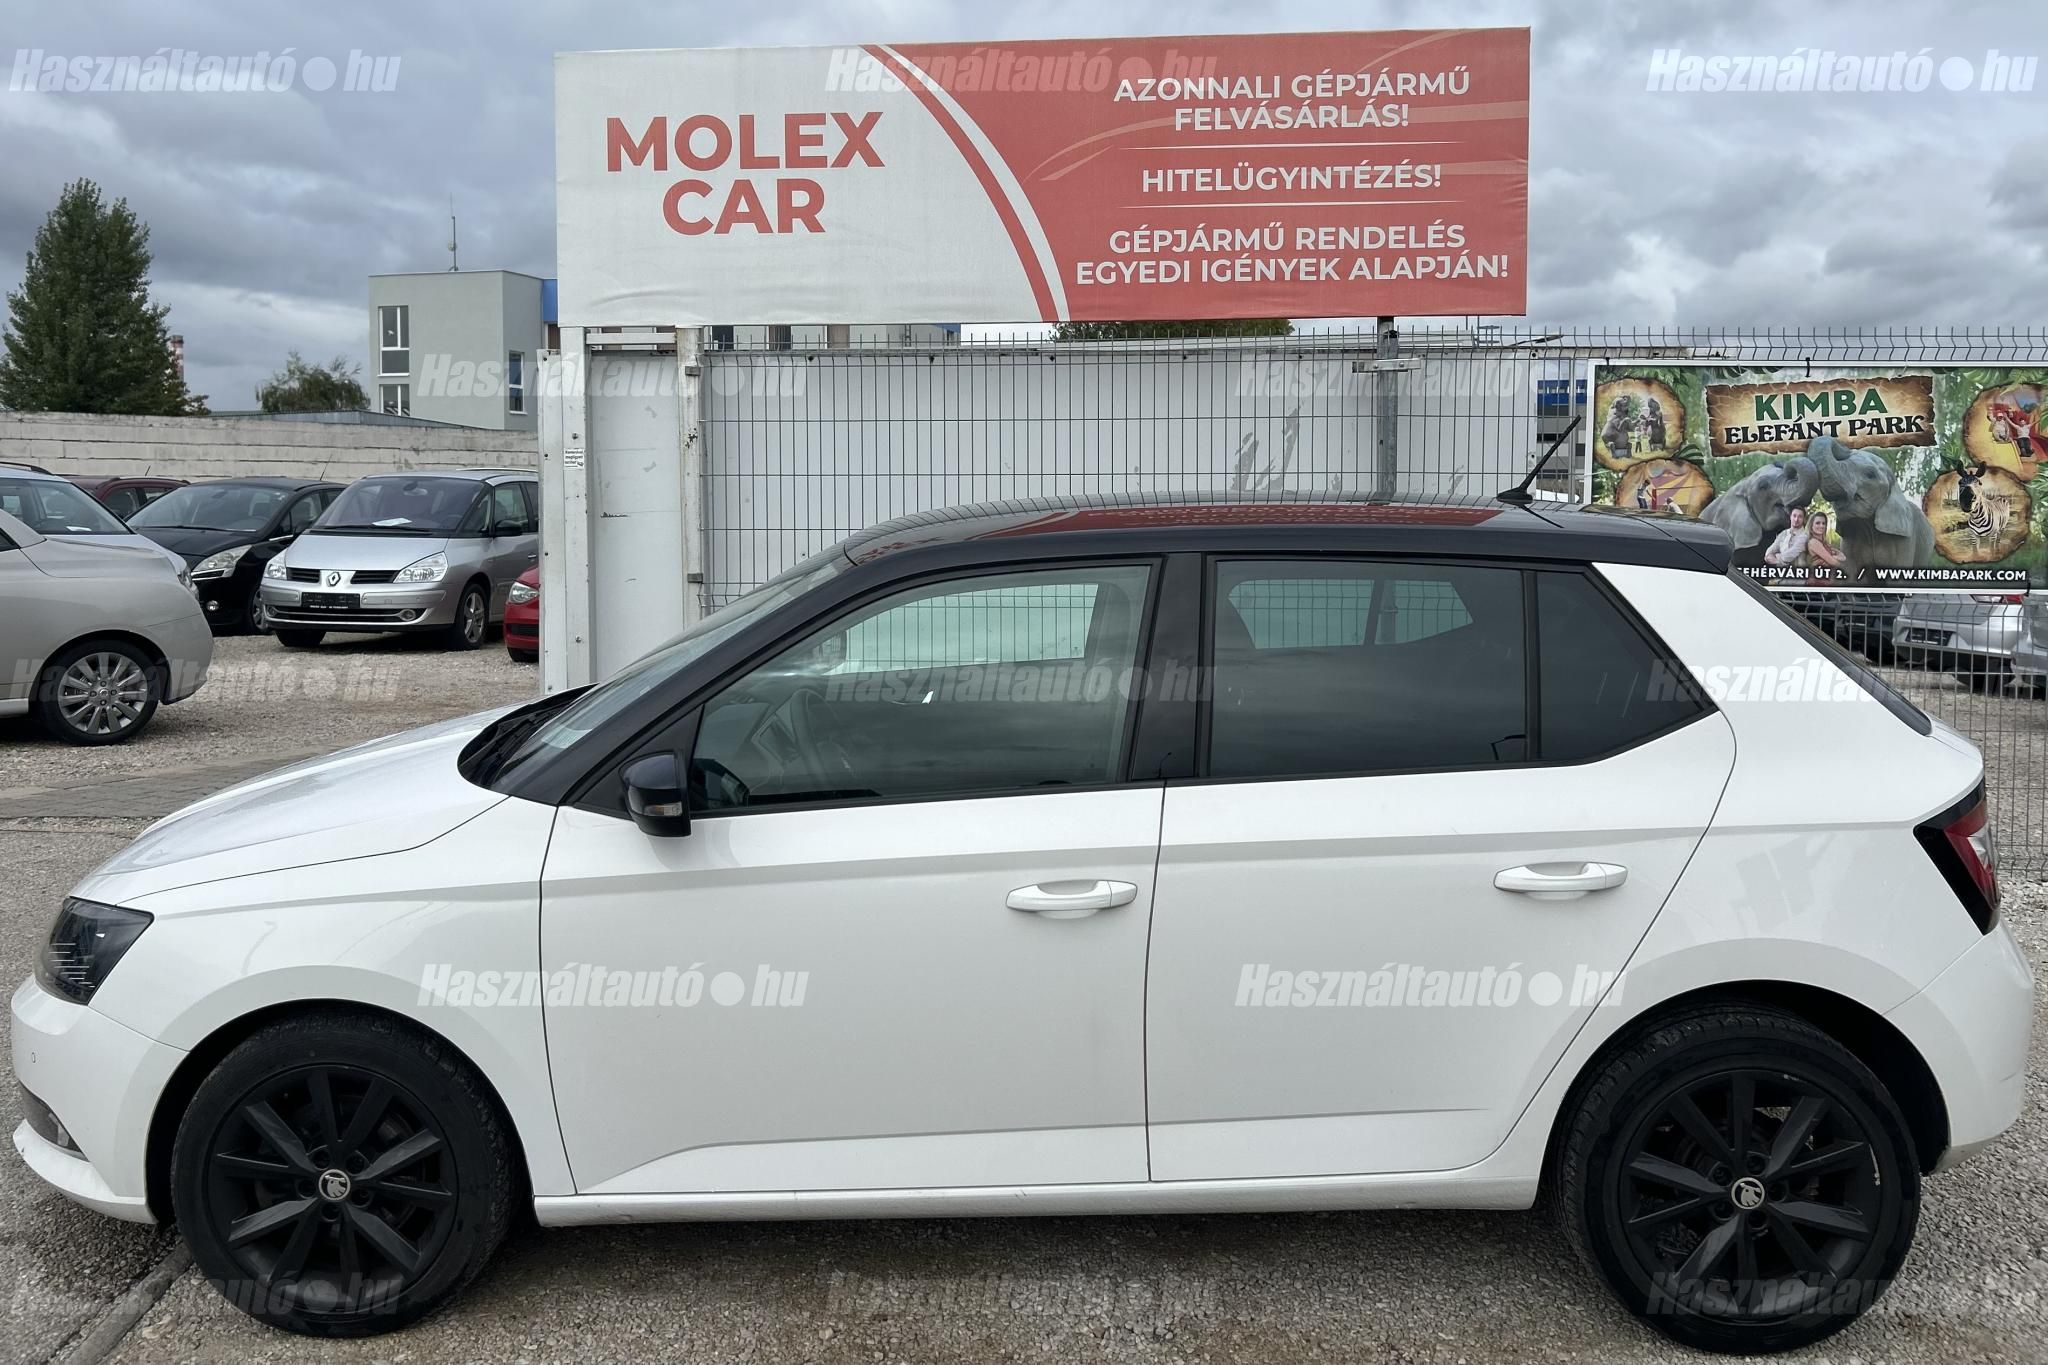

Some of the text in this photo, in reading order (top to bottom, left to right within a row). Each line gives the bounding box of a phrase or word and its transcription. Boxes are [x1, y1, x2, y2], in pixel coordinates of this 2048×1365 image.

[1114, 66, 1470, 102] AZONNALI GÉPJÁRMŰ
[1175, 99, 1409, 131] FELVÁSÁRLÁS!
[607, 112, 885, 172] MOLEX
[1142, 159, 1441, 193] HITELÜGYINTÉZÉS!
[662, 178, 826, 235] CAR
[1109, 219, 1466, 254] GÉPJÁRMŰ RENDELÉS
[1077, 250, 1509, 284] EGYEDI IGÉNYEK ALAPJÁN!
[1755, 388, 1887, 421] KIMBA
[1724, 415, 1925, 444] ELEFÁNT PARK
[1738, 565, 1809, 579] EHÉRVÁRI
[1814, 566, 1831, 578] ÚT
[1836, 570, 1847, 579] 2.
[1876, 568, 2027, 581] WWW.KIMBAPARK.COM
